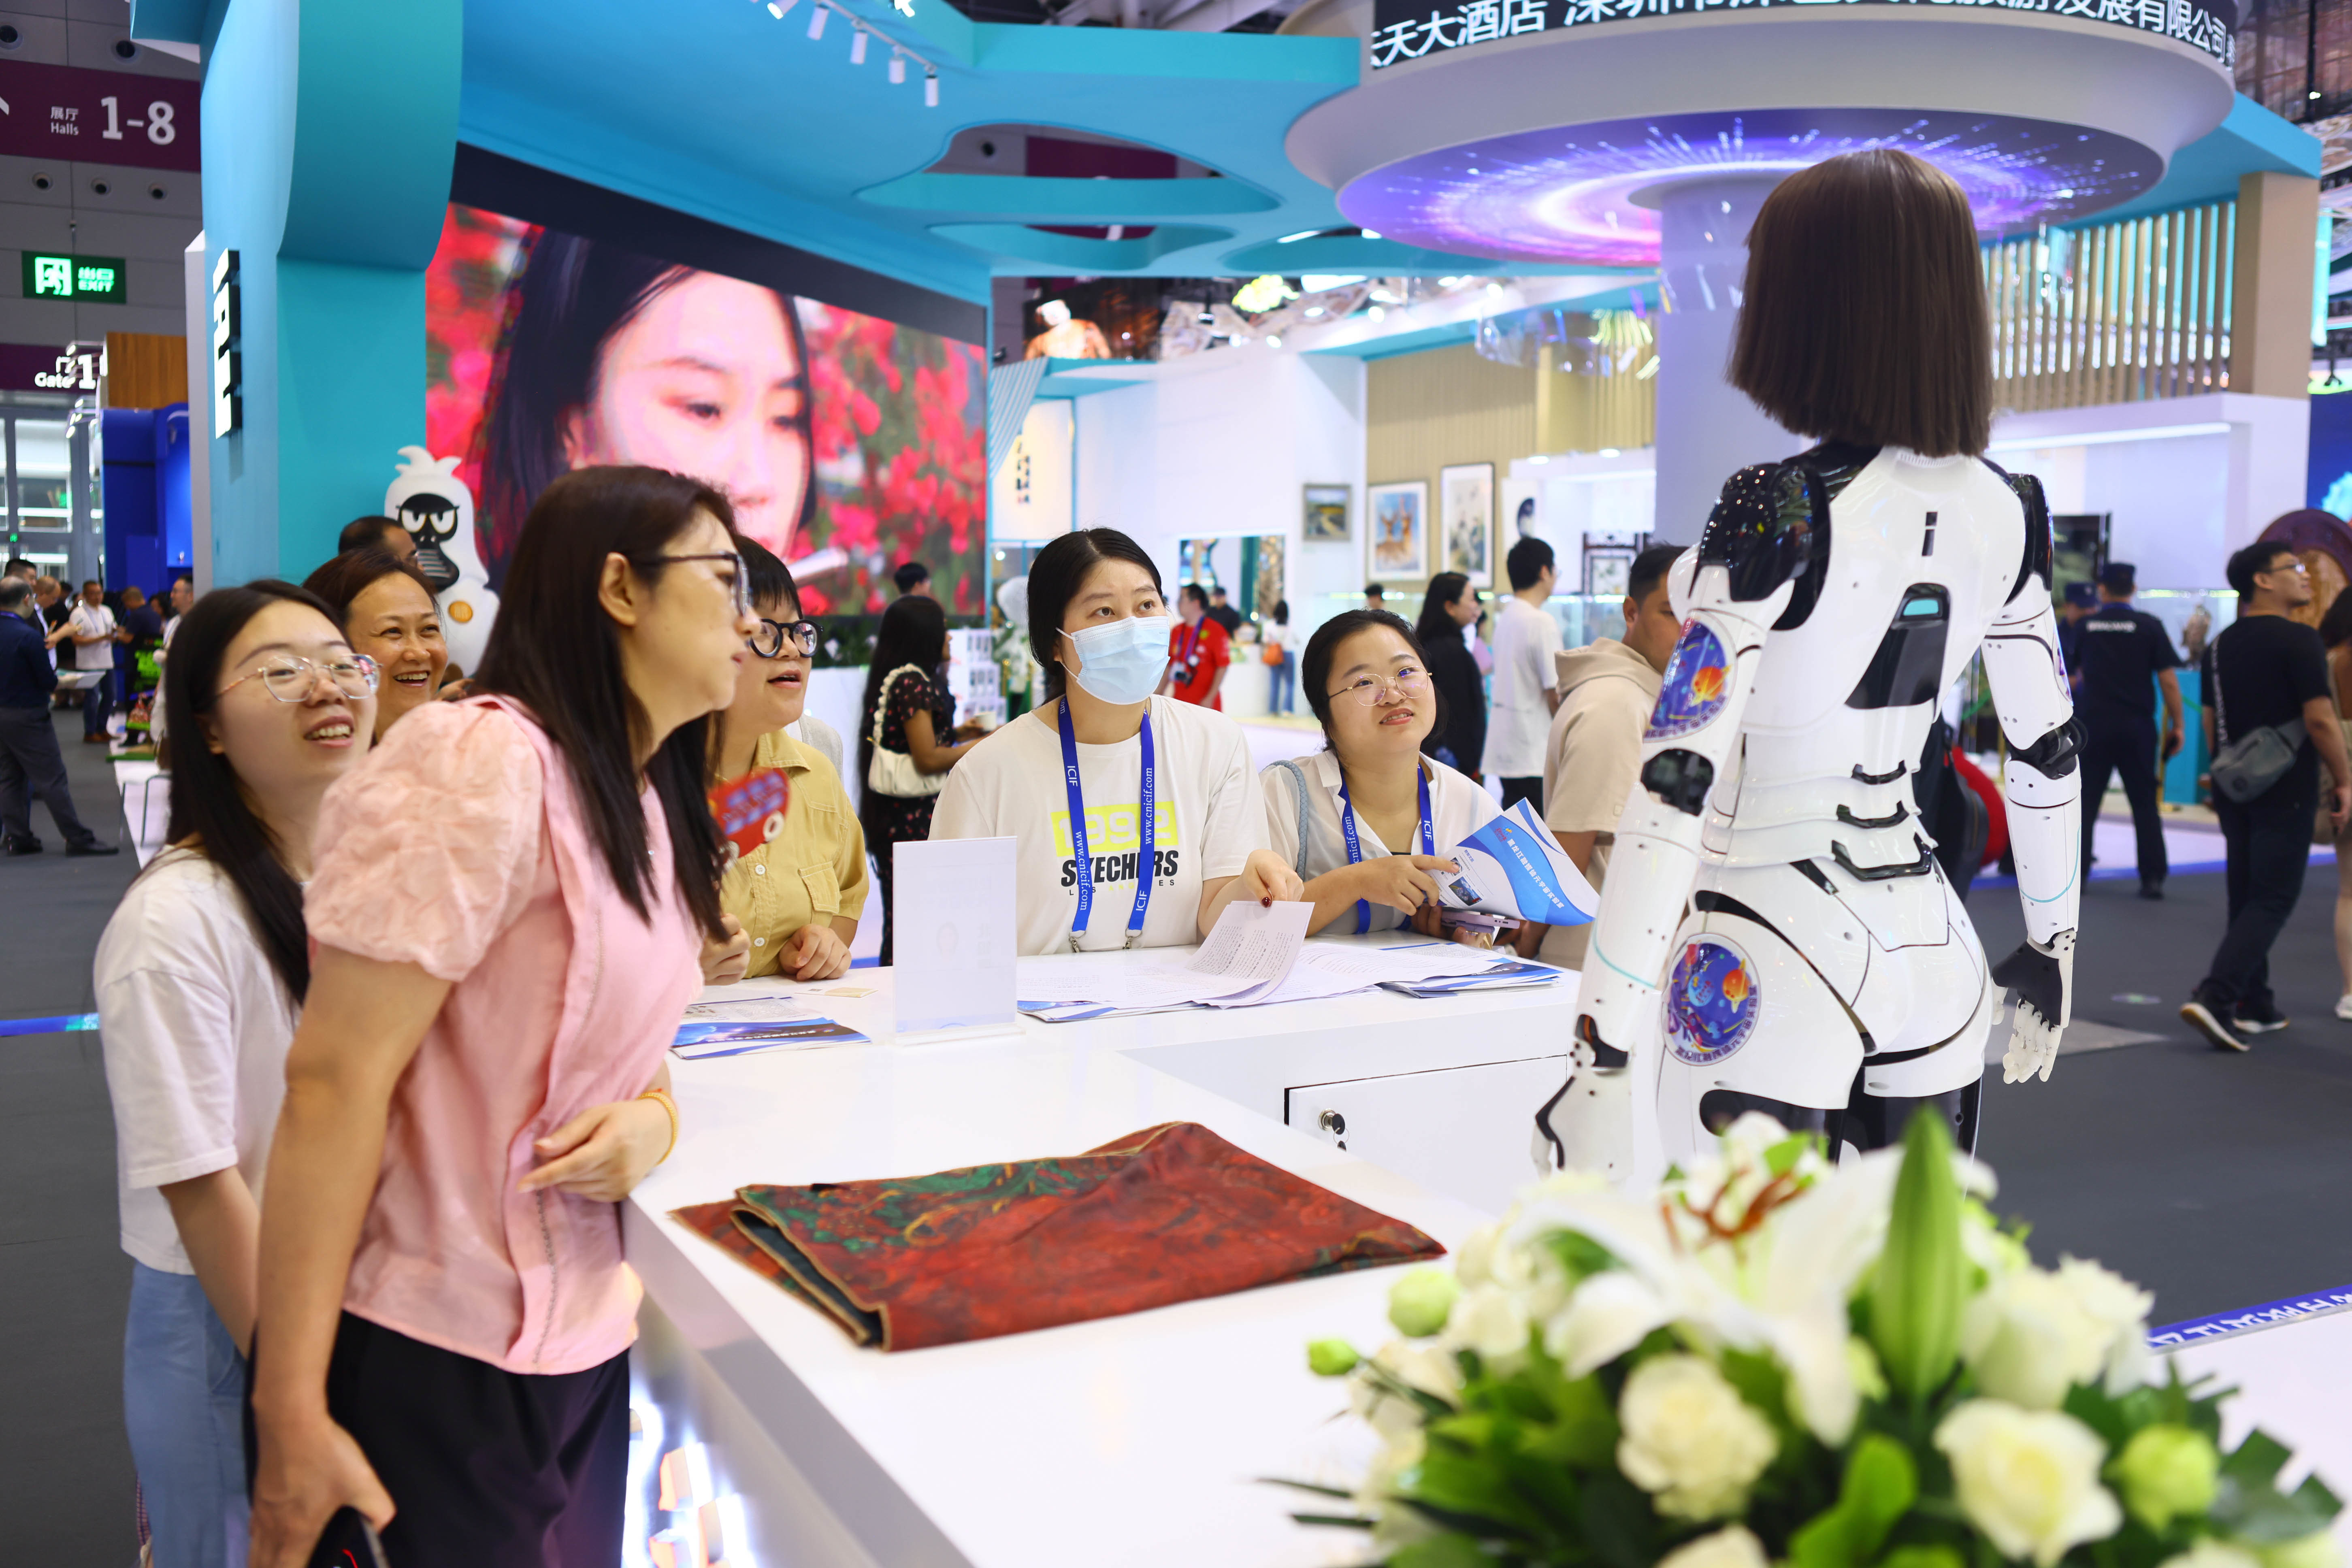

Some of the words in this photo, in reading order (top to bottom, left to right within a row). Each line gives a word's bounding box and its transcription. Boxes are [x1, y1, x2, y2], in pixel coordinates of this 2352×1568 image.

[51, 106, 79, 121] 展厅
[101, 96, 175, 145] 1-8
[51, 121, 79, 136] Halls
[78, 279, 114, 292] EXIT
[77, 354, 96, 390] 1
[1067, 766, 1078, 787] ICIF
[1143, 768, 1153, 845] www.cnicif.com
[1059, 809, 1171, 848] 1992
[1424, 820, 1432, 841] ICIF
[1061, 850, 1178, 887] SECHRS
[1075, 831, 1091, 911] www.cnicif.com
[1069, 886, 1096, 896] LS
[1108, 879, 1174, 891] ANGES
[1136, 890, 1147, 911] ICIF
